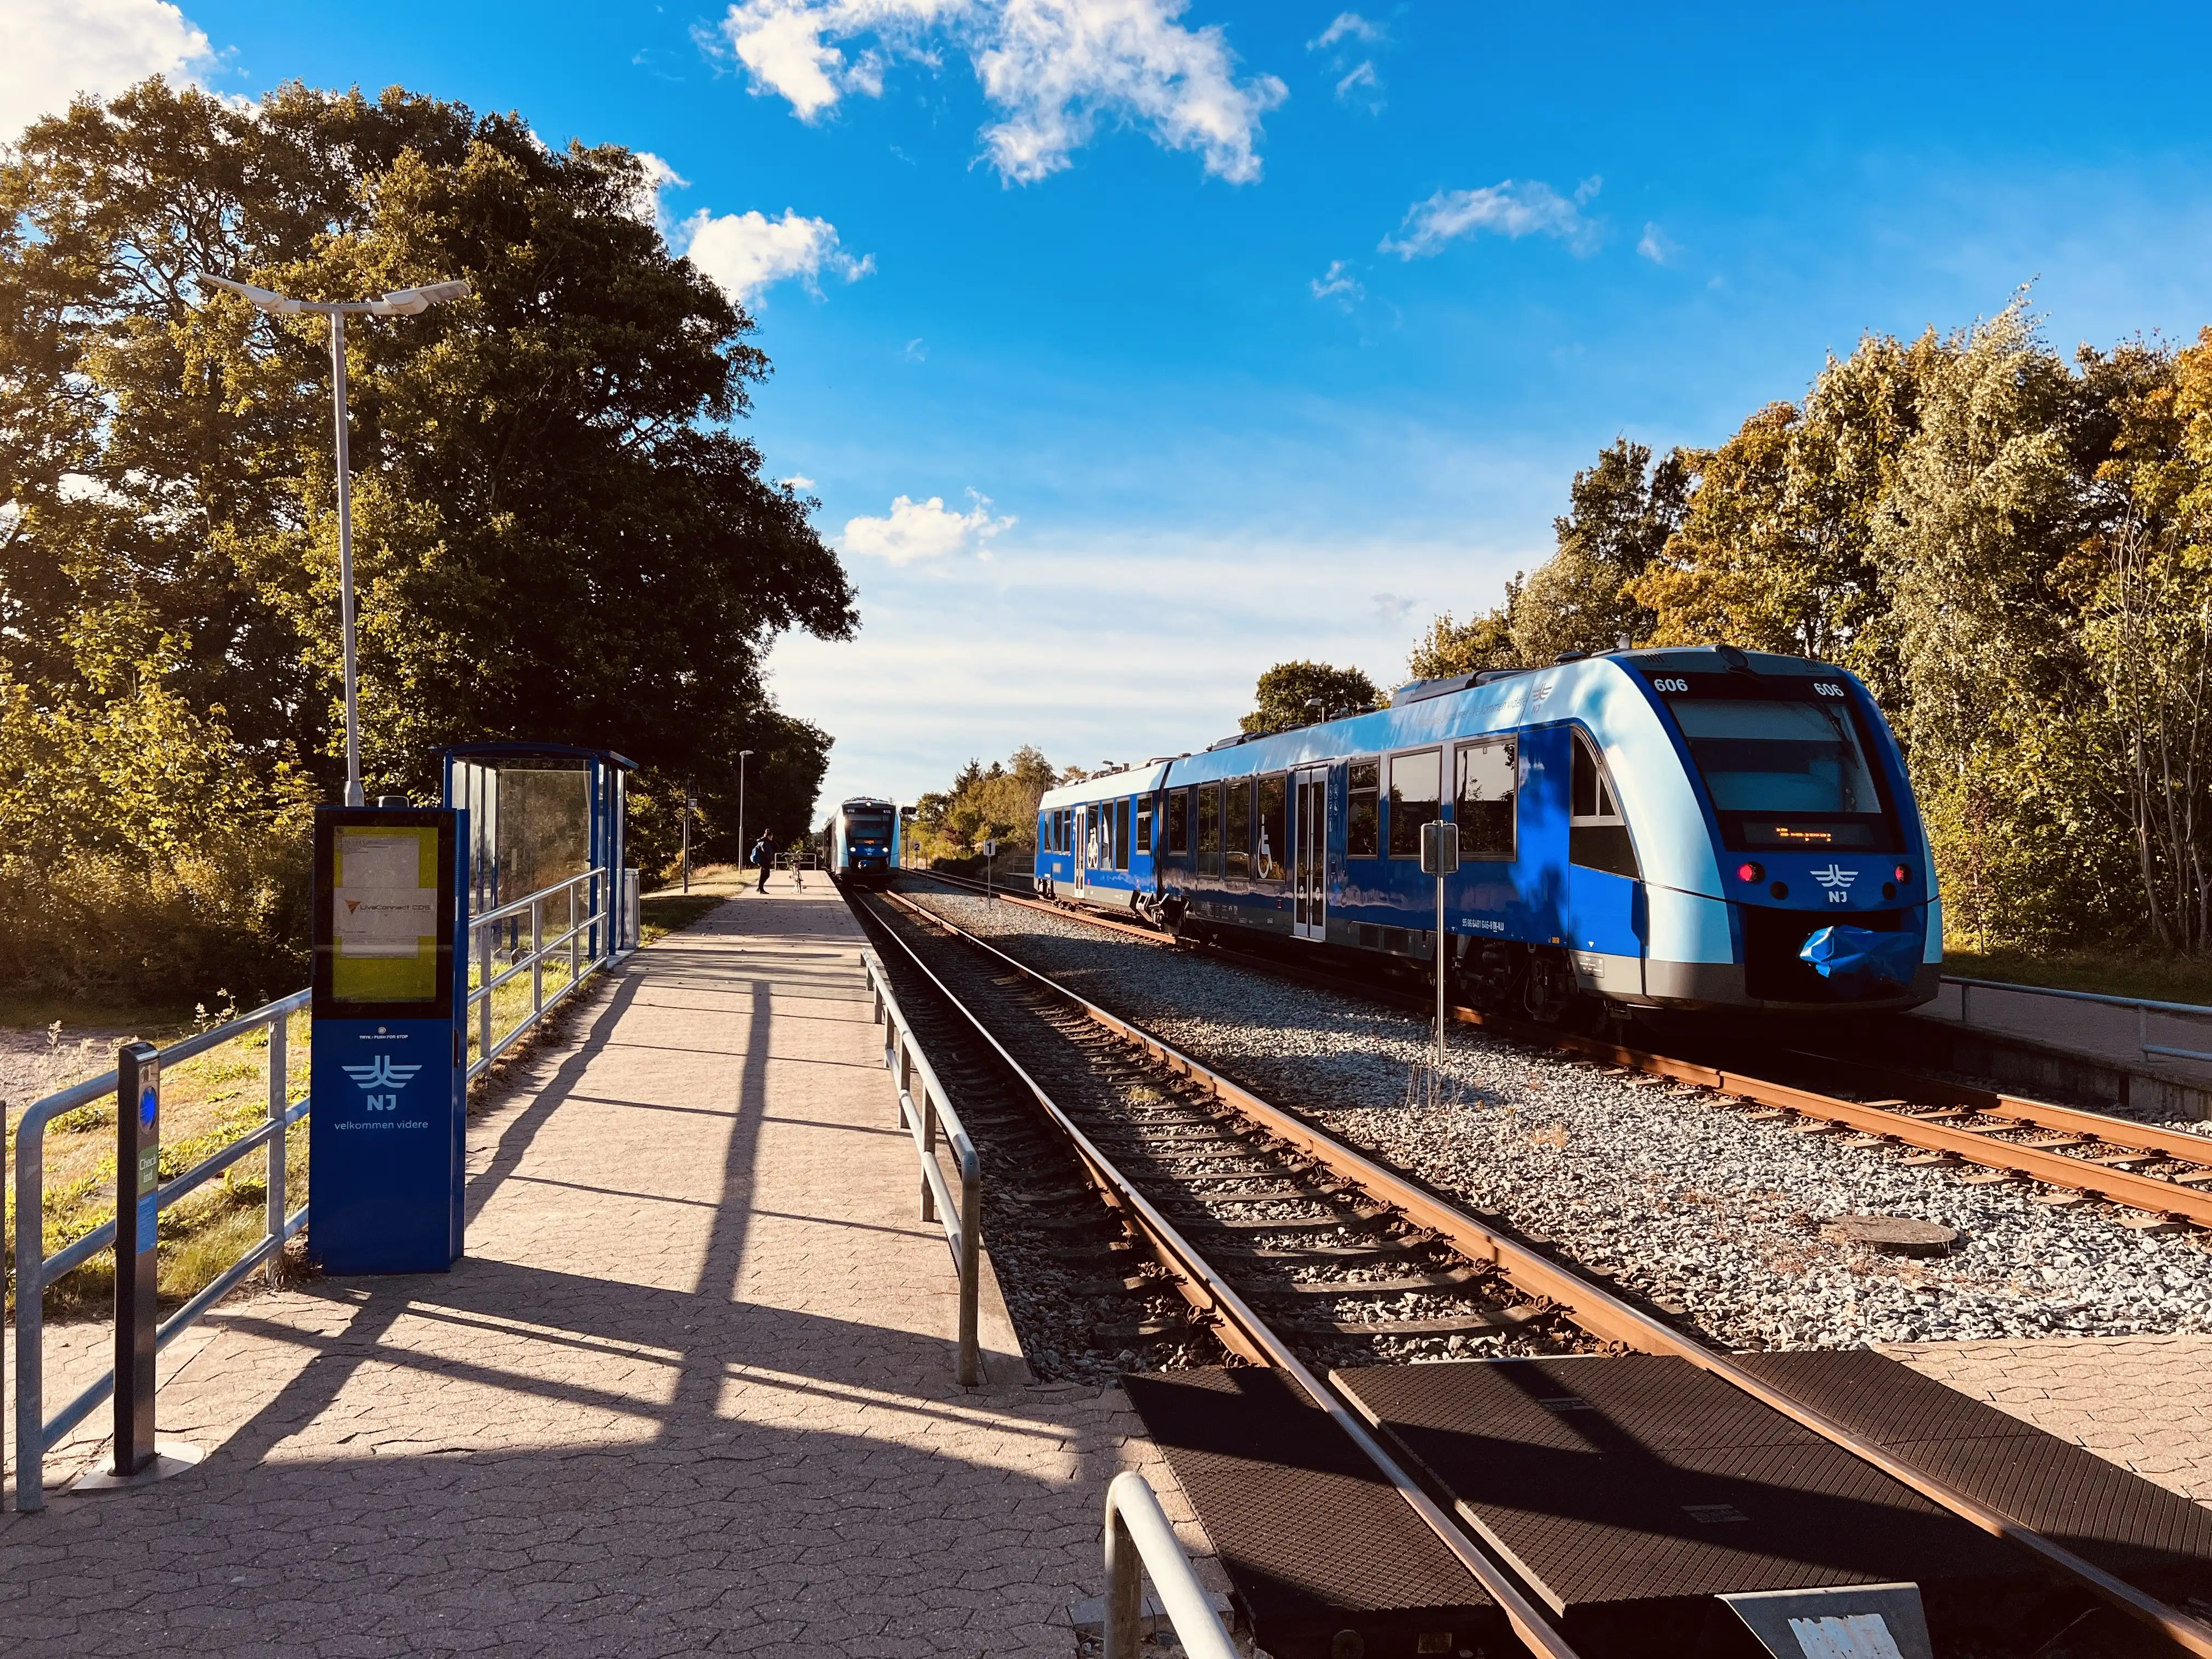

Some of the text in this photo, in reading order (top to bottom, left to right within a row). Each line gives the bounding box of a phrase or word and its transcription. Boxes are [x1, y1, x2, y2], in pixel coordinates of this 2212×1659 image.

[1654, 679, 1688, 692] 606
[1814, 682, 1844, 697] 606
[1532, 704, 1541, 714] NJ
[987, 842, 992, 854] 1
[1829, 891, 1847, 902] NJ
[367, 1094, 396, 1111] NJ
[334, 1120, 428, 1130] velkommen videre
[139, 1154, 158, 1171] Check
[144, 1169, 153, 1183] ind
